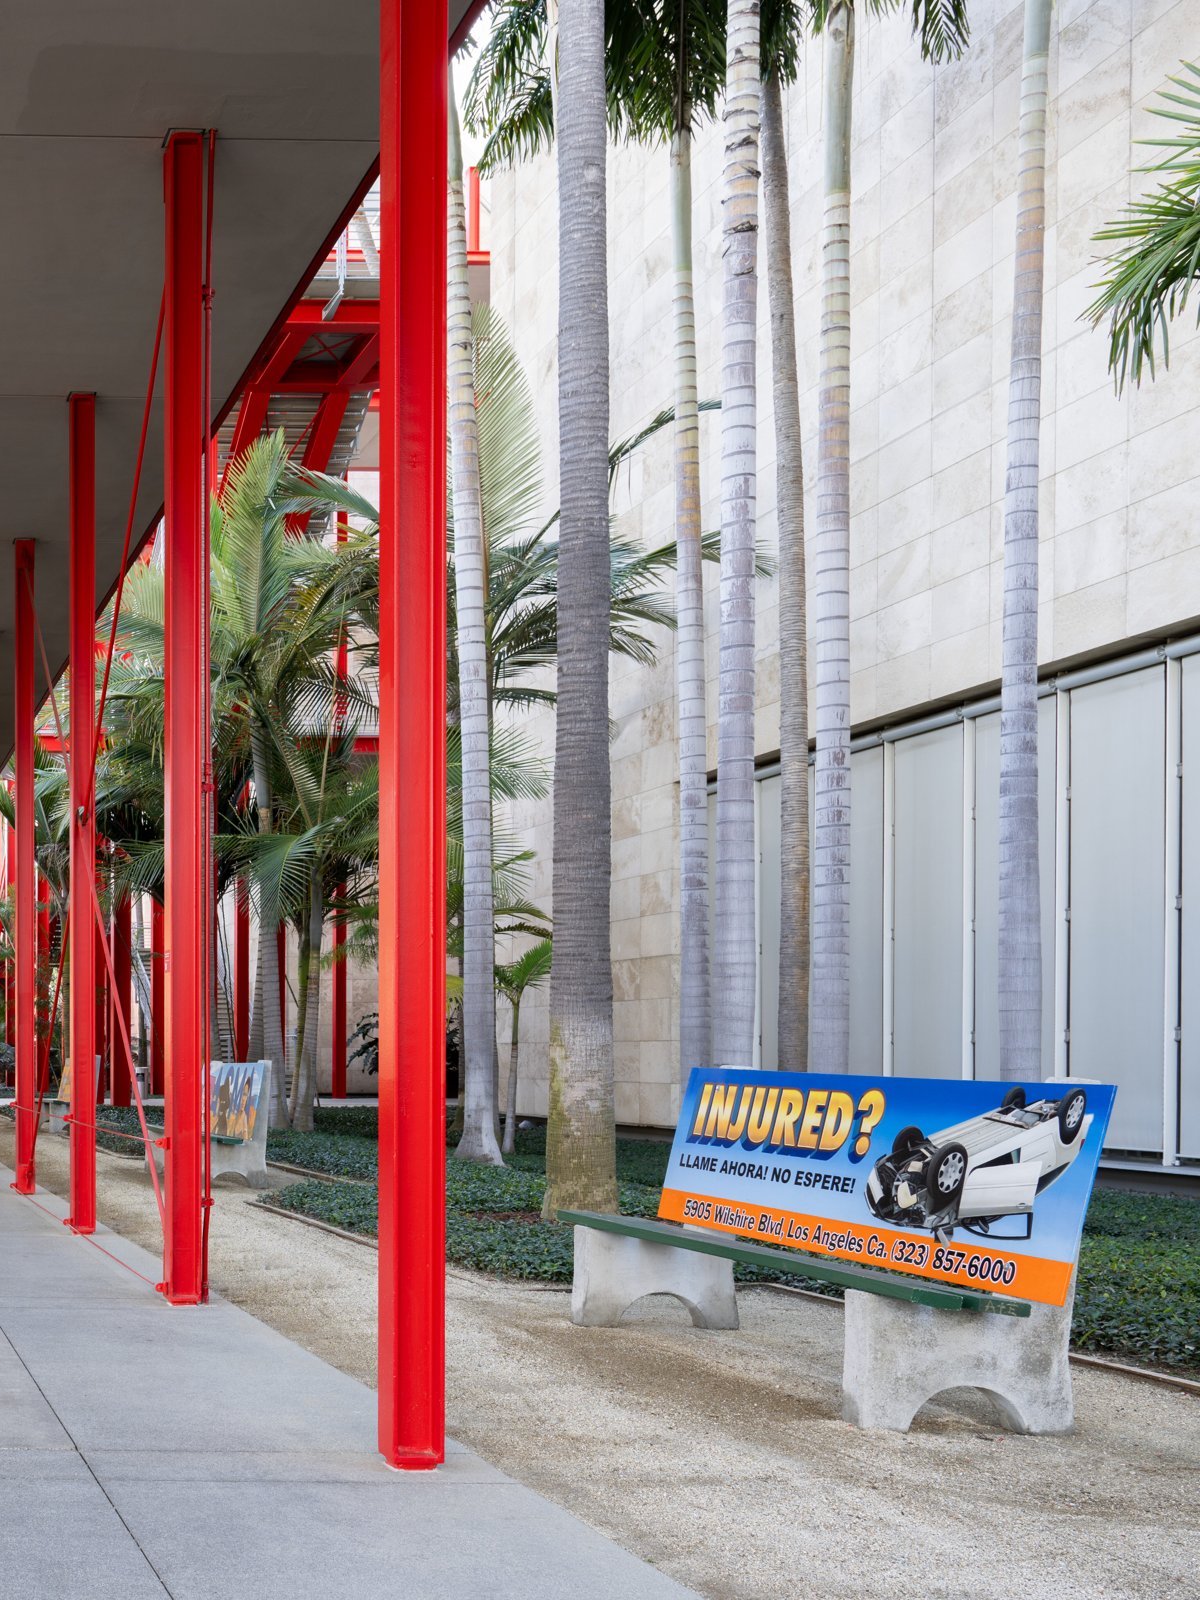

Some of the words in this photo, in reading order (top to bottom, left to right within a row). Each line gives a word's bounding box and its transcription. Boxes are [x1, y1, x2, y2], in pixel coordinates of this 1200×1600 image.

[689, 1082, 886, 1162] INJURED?
[679, 1153, 718, 1172] LLAME
[719, 1160, 769, 1180] AHORA!
[770, 1167, 792, 1184] NO
[794, 1170, 856, 1194] ESPERE!
[683, 1199, 712, 1220] 5905
[713, 1204, 756, 1230] Wilshire
[757, 1213, 785, 1240] Blvd,
[786, 1219, 810, 1242] Los
[811, 1224, 864, 1253] Angeles
[866, 1234, 888, 1259] Ca.
[890, 1239, 930, 1268] (323)
[932, 1248, 1017, 1286] 857-6000
